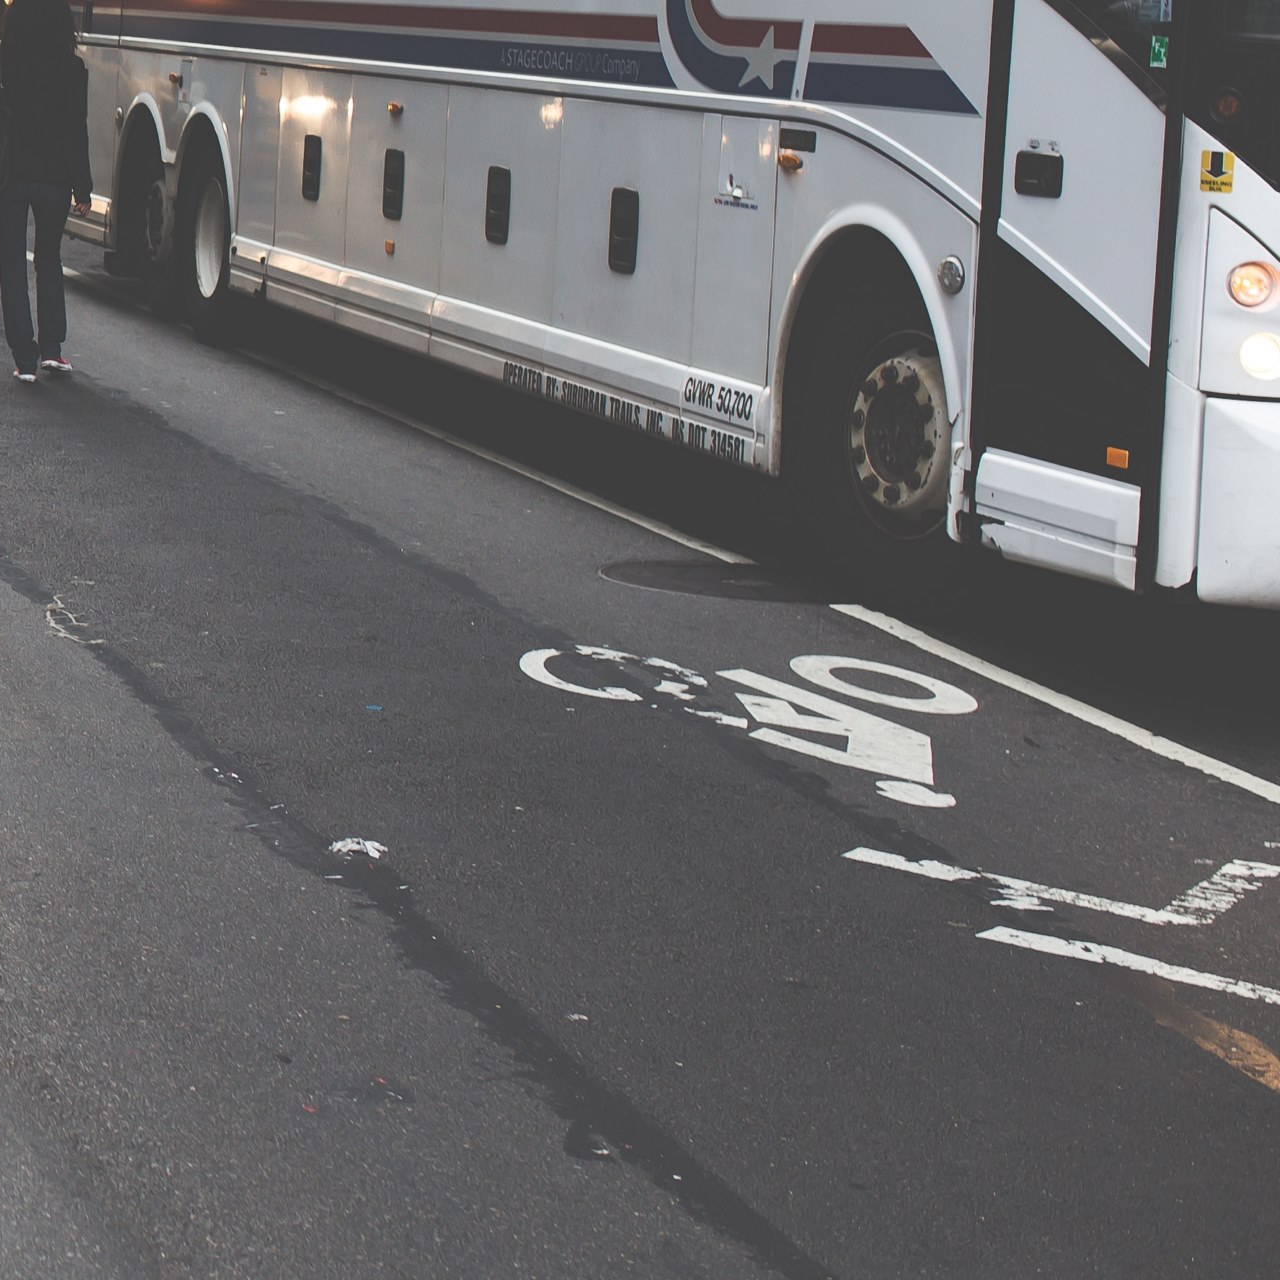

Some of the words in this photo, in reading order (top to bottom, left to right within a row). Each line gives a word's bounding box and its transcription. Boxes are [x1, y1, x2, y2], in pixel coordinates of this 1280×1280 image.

[507, 47, 573, 72] STAGECOACH
[574, 51, 601, 74] GROUP
[602, 53, 641, 82] Company
[684, 376, 716, 408] GVWR
[503, 360, 543, 394] OPERATED
[545, 375, 560, 399] BY:
[561, 380, 607, 418] SUBURBAN
[671, 417, 686, 442] US
[688, 421, 708, 450] DOT
[709, 429, 746, 463] 314581
